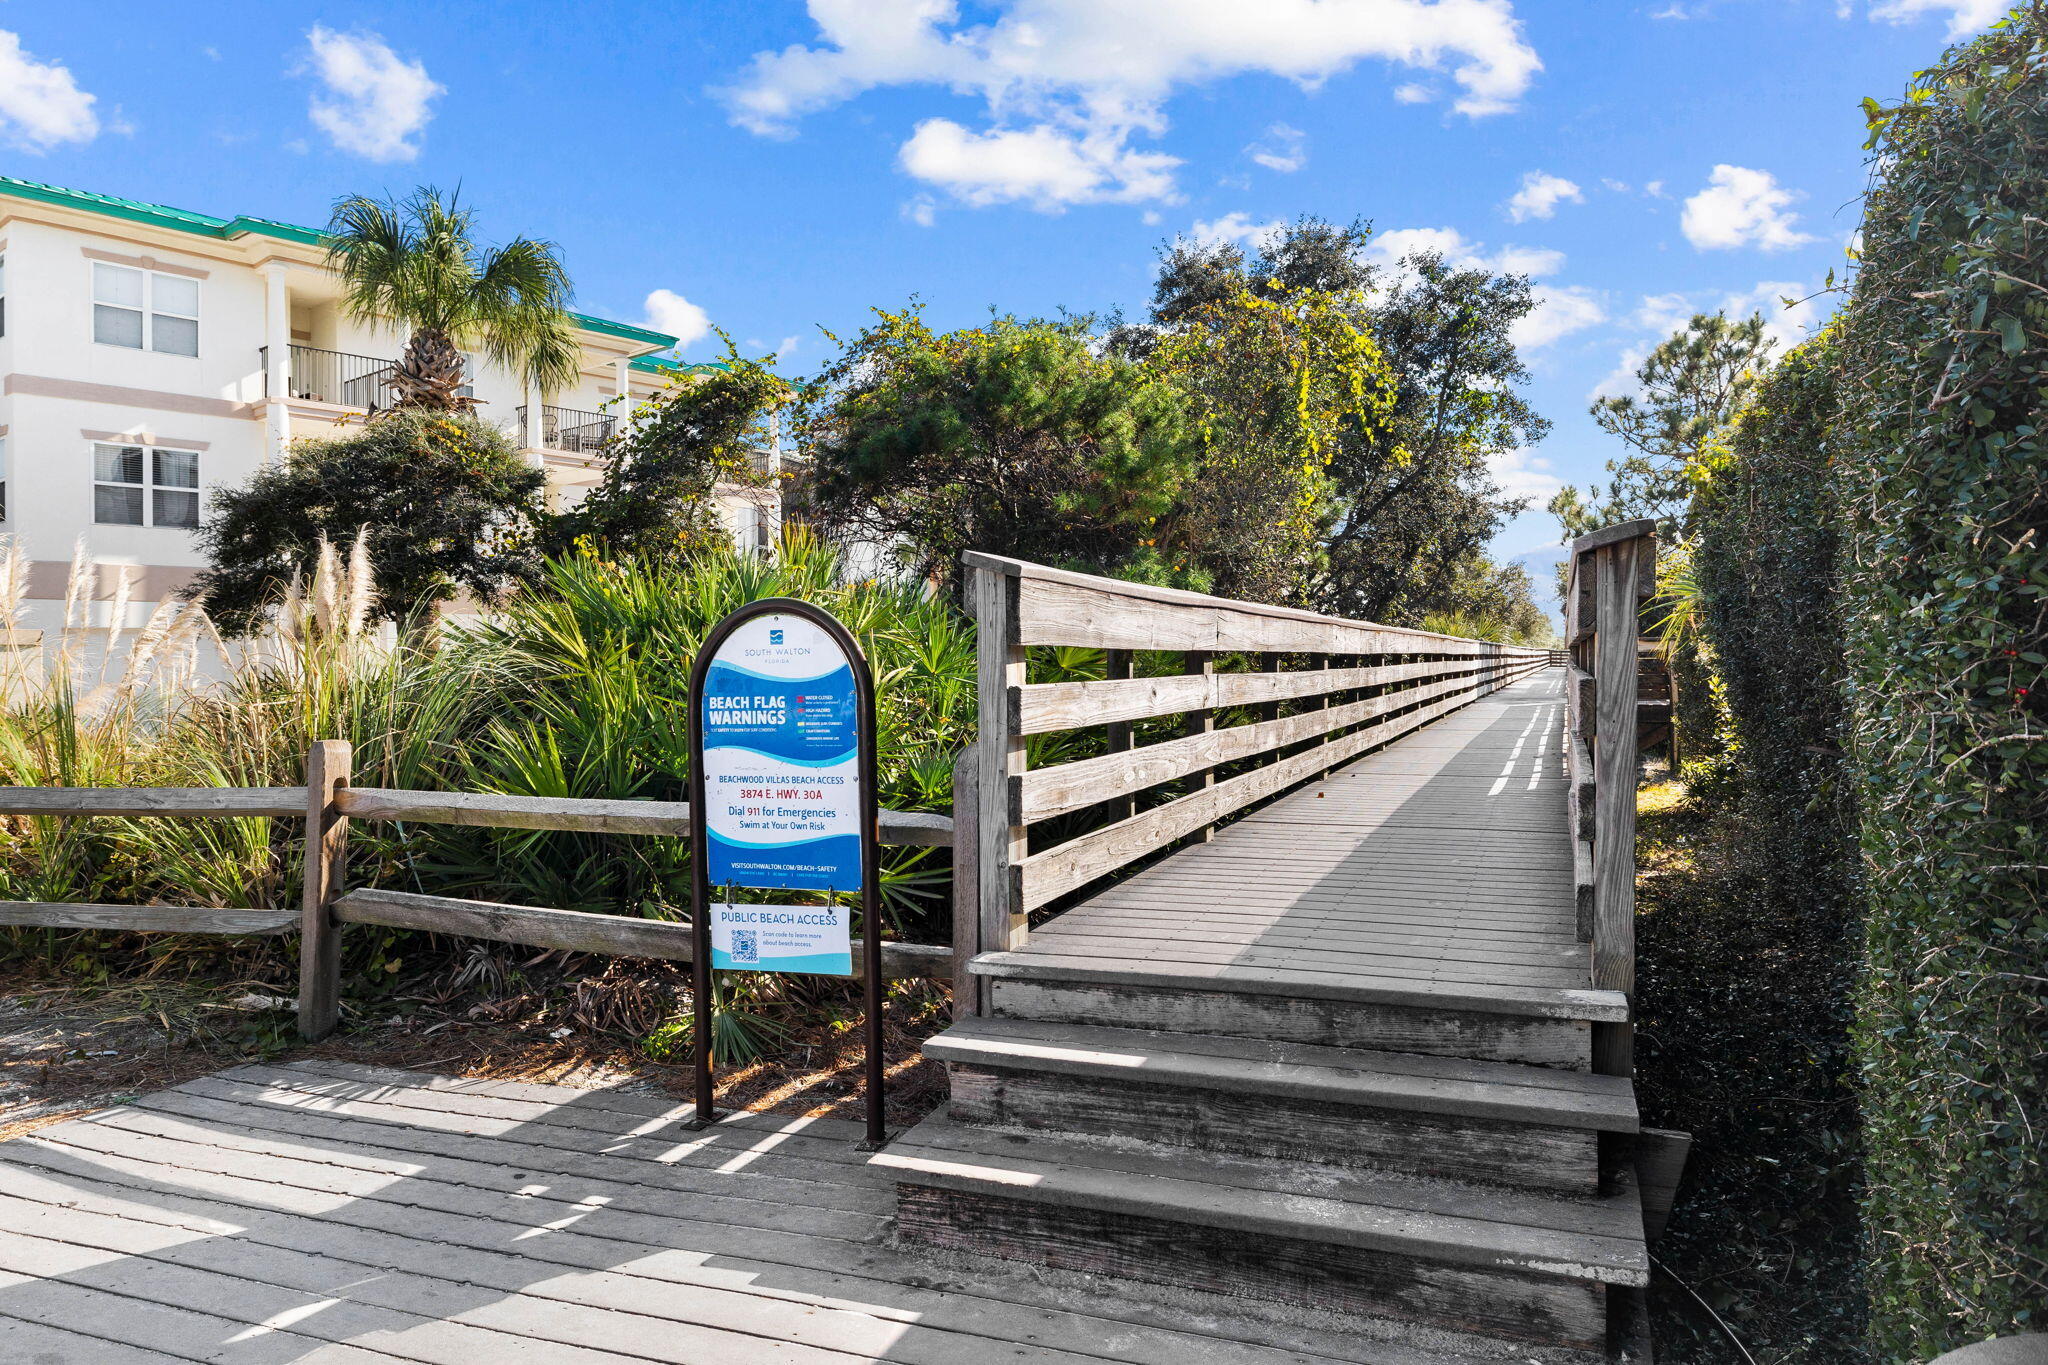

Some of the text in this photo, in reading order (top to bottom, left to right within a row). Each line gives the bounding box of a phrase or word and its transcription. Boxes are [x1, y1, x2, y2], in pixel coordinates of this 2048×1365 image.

[710, 696, 786, 708] BEACH FLAG
[709, 710, 786, 725] WARNINGS
[719, 776, 764, 784] BEACHWOOD
[792, 776, 815, 784] BEACH
[817, 776, 844, 784] ACCESS
[740, 790, 823, 800] 3874 E. HWY. 30A
[729, 806, 836, 820] Dial 911 for Emergencies
[740, 821, 760, 829] Swim
[772, 821, 788, 829] Your
[790, 822, 808, 830] Own
[809, 822, 825, 830] Risk
[731, 862, 837, 873] VISITSOUTHWALTON.COM/BEACH-SAFETY
[721, 912, 838, 926] PUBLIC BEACH ACCESS
